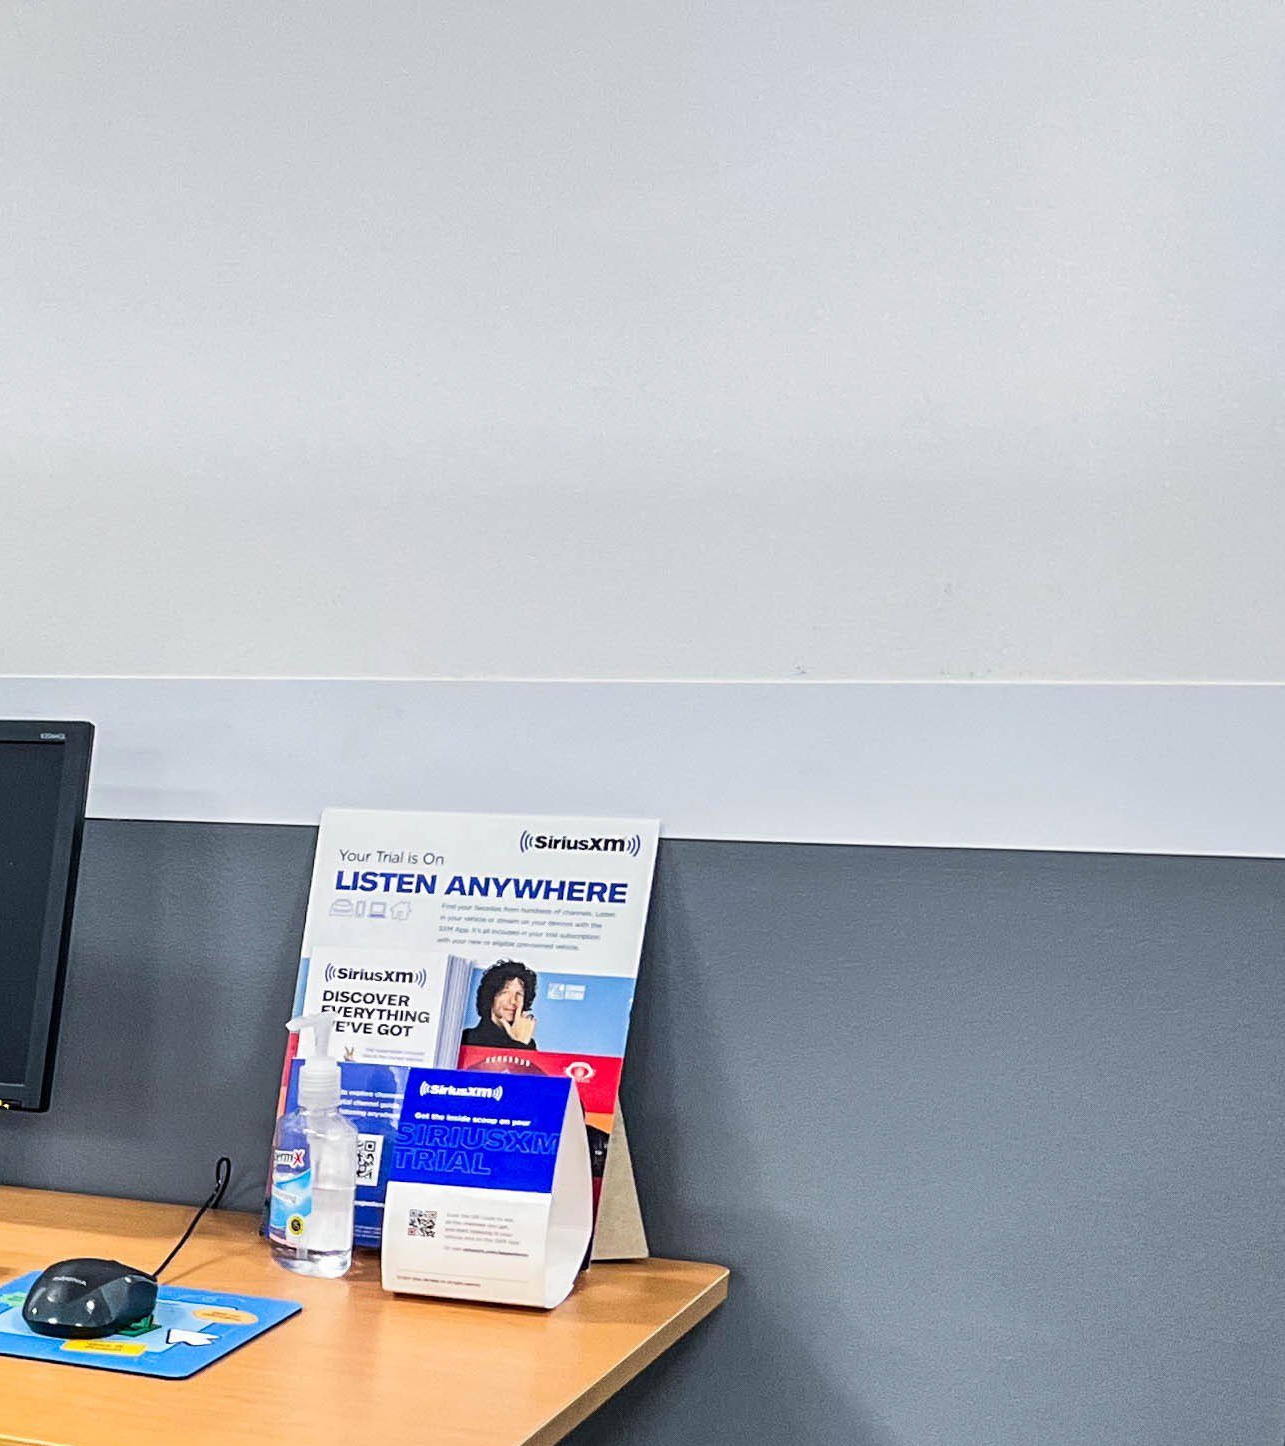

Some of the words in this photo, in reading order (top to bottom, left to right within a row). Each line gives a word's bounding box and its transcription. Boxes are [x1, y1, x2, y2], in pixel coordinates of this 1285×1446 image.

[339, 849, 371, 863] Your
[376, 850, 404, 864] Trial
[407, 852, 419, 865] is
[423, 853, 445, 866] On
[335, 870, 437, 895] LISTEN
[444, 875, 628, 904] ANYWHERE
[322, 990, 411, 1007] DISCOVER
[377, 1024, 414, 1037] GOT
[414, 1111, 429, 1120] Get
[430, 1113, 445, 1122] the
[446, 1114, 471, 1123] inside
[472, 1116, 497, 1126] scoop
[499, 1118, 511, 1126] on
[512, 1119, 532, 1127] your
[395, 1122, 562, 1155] SIRIUSXM
[394, 1146, 492, 1176] TRIAL
